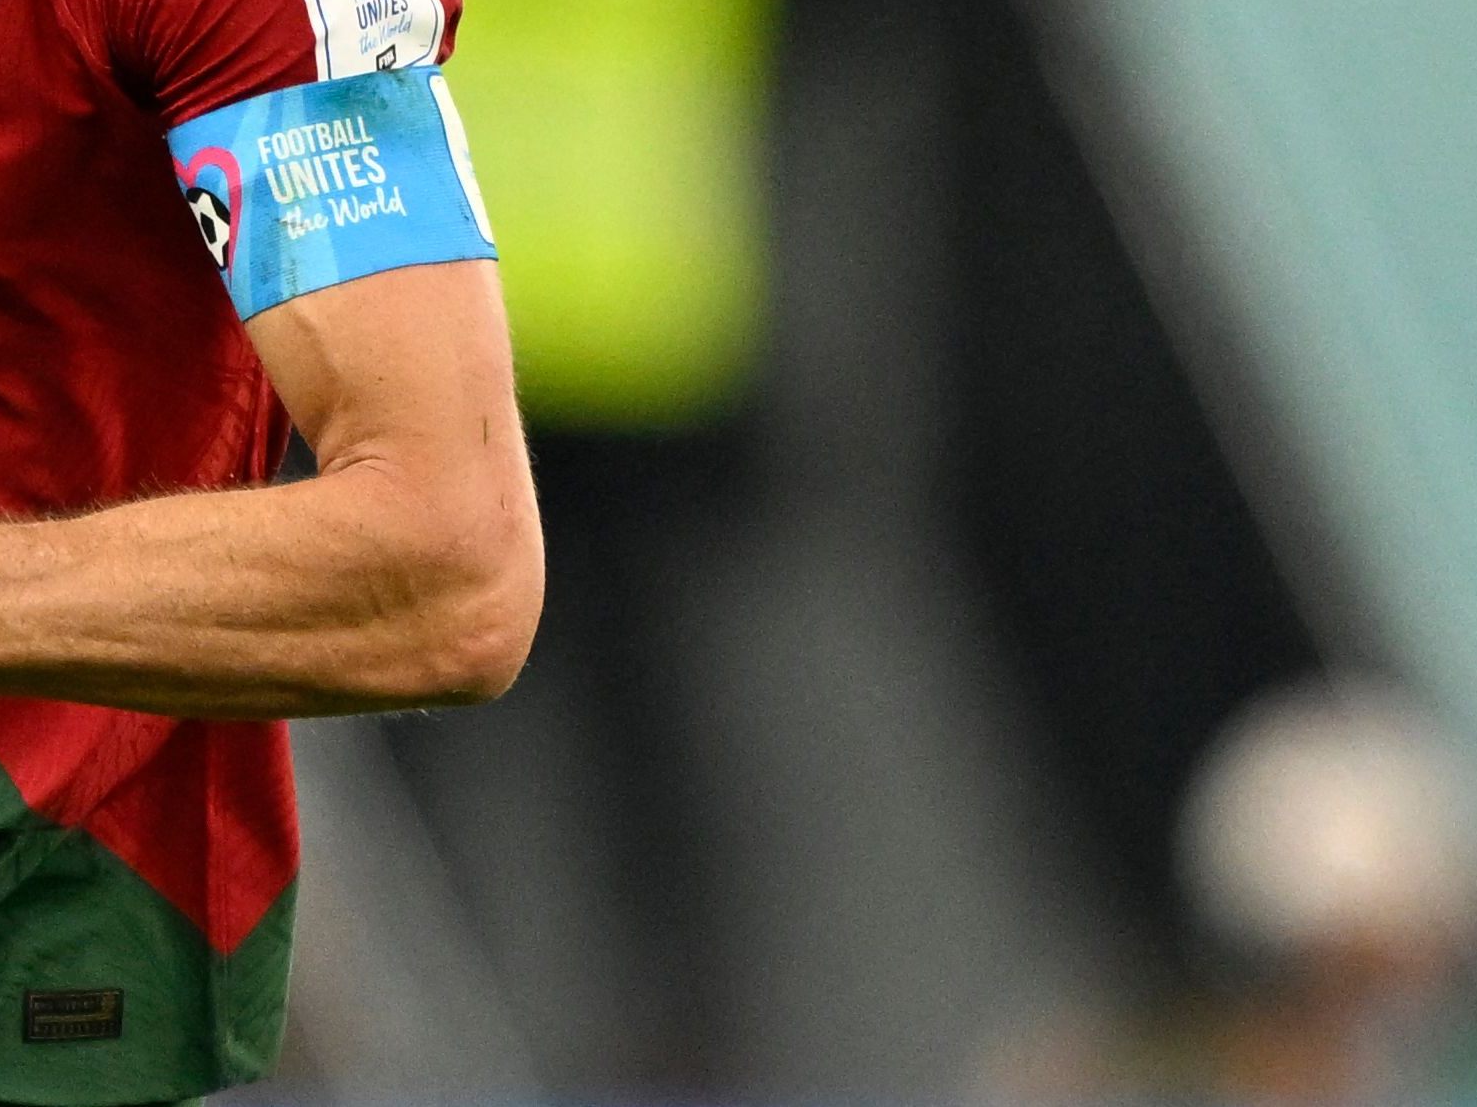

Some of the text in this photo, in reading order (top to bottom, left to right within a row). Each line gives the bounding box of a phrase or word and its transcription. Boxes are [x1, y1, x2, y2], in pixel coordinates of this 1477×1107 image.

[378, 13, 413, 45] World
[257, 116, 374, 164] FOOTBALL
[264, 145, 386, 205] UNITES
[281, 186, 407, 239] the World
